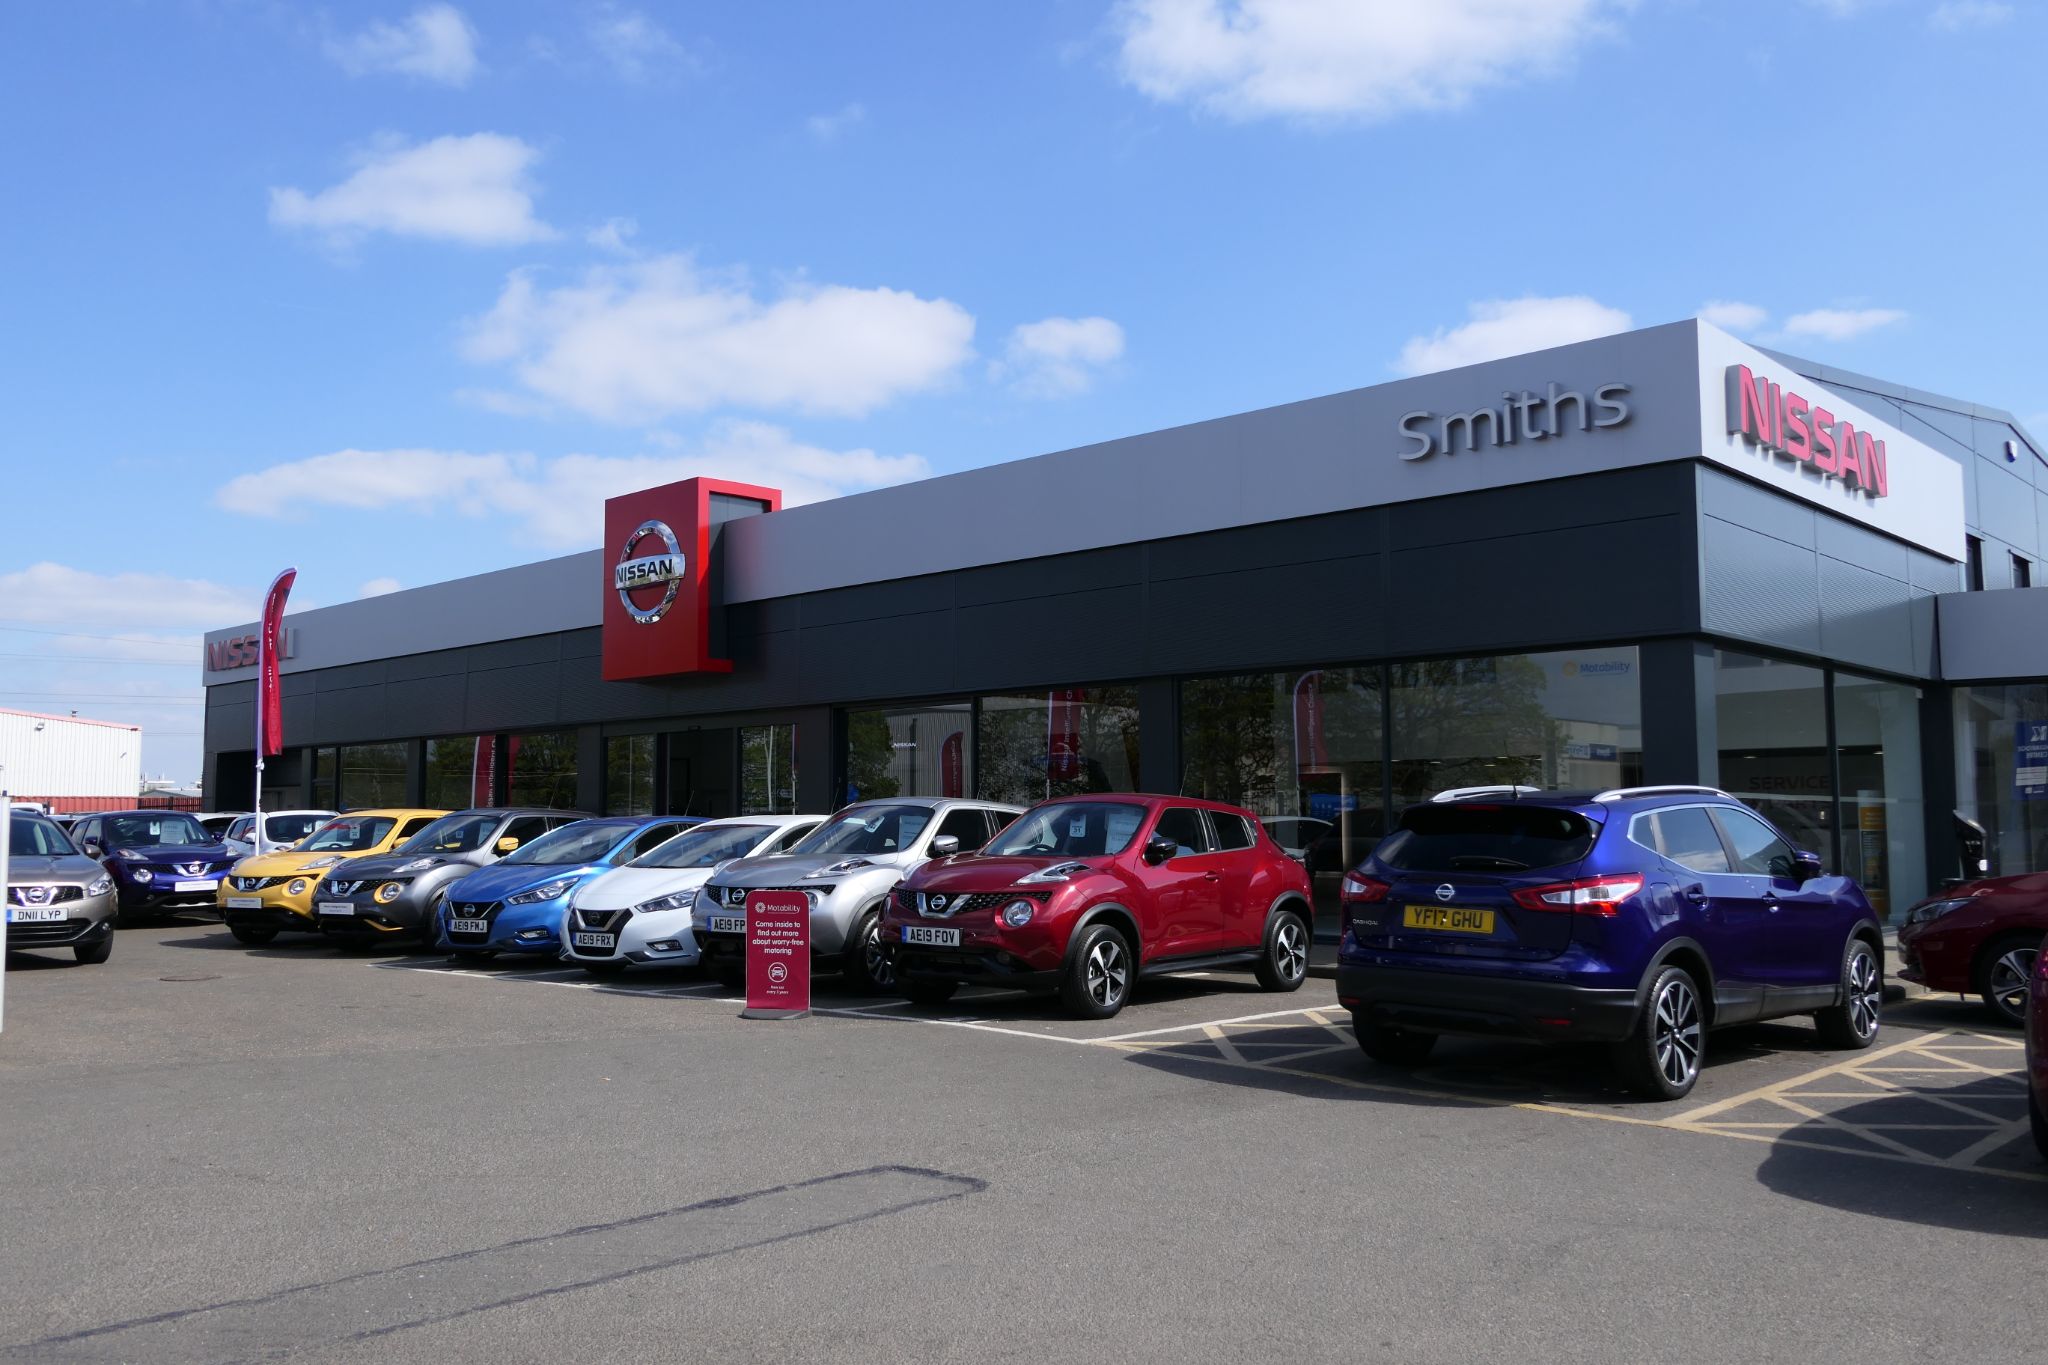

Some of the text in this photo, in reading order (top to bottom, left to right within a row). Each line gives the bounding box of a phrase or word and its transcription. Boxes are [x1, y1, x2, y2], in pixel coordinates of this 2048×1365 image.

[1398, 381, 1633, 462] Smiths
[1726, 363, 1888, 499] NISSAN
[616, 558, 673, 585] NISSAN
[1580, 661, 1630, 673] Motability
[1750, 776, 1829, 790] SERVICE
[18, 910, 61, 920] DN11 LYP
[767, 904, 801, 913] Motability
[714, 918, 746, 931] AE19 FP
[755, 920, 801, 928] Come inside to
[1414, 908, 1483, 929] YF17 GHU
[453, 921, 469, 931] AE19
[578, 933, 611, 946] AE19 FRX
[910, 928, 955, 943] AE19 FOV
[772, 938, 804, 947] worry-free
[764, 947, 792, 955] motoring
